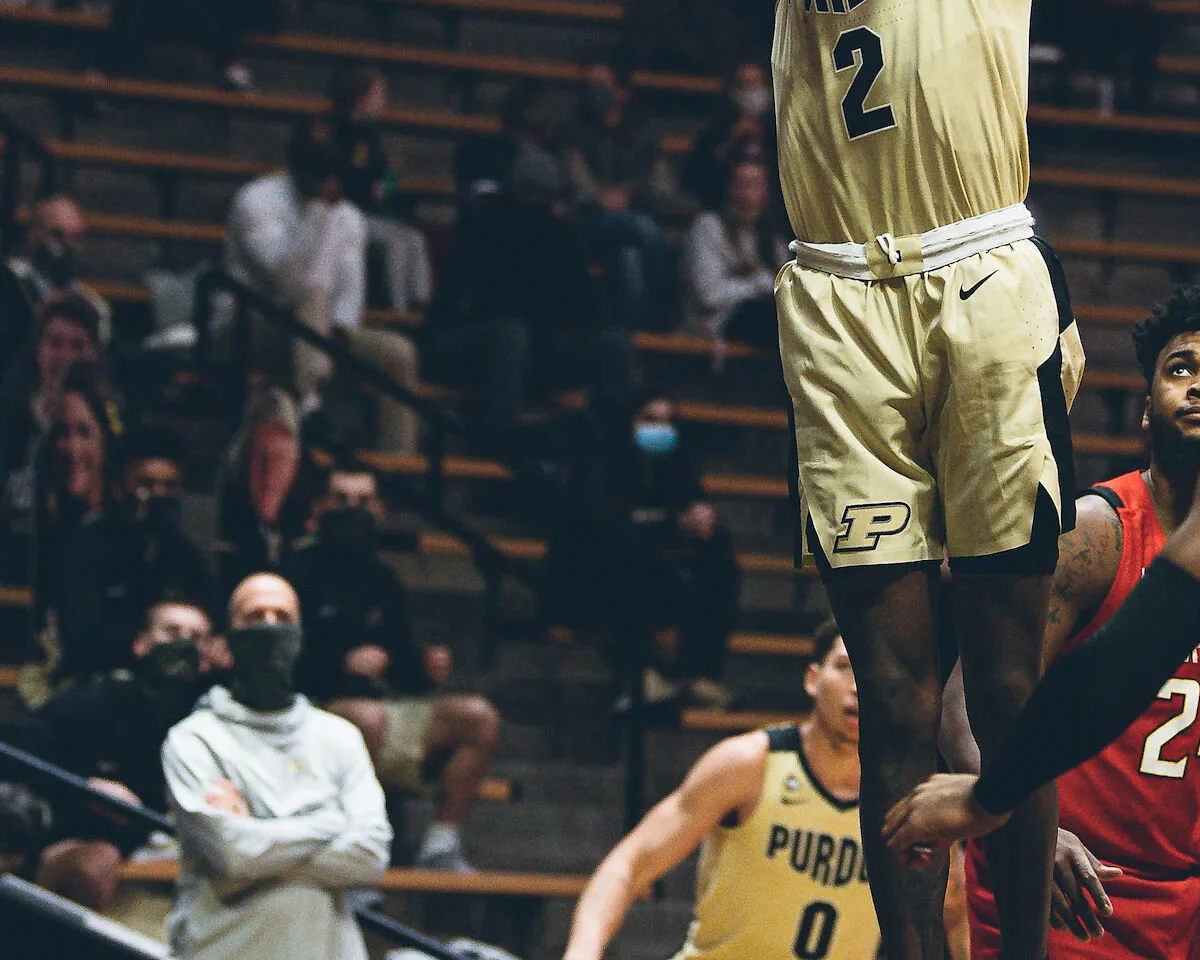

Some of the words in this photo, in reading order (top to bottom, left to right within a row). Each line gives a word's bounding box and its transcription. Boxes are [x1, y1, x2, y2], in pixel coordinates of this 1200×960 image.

[831, 25, 898, 141] 2
[832, 501, 912, 554] P
[792, 900, 838, 960] 0
